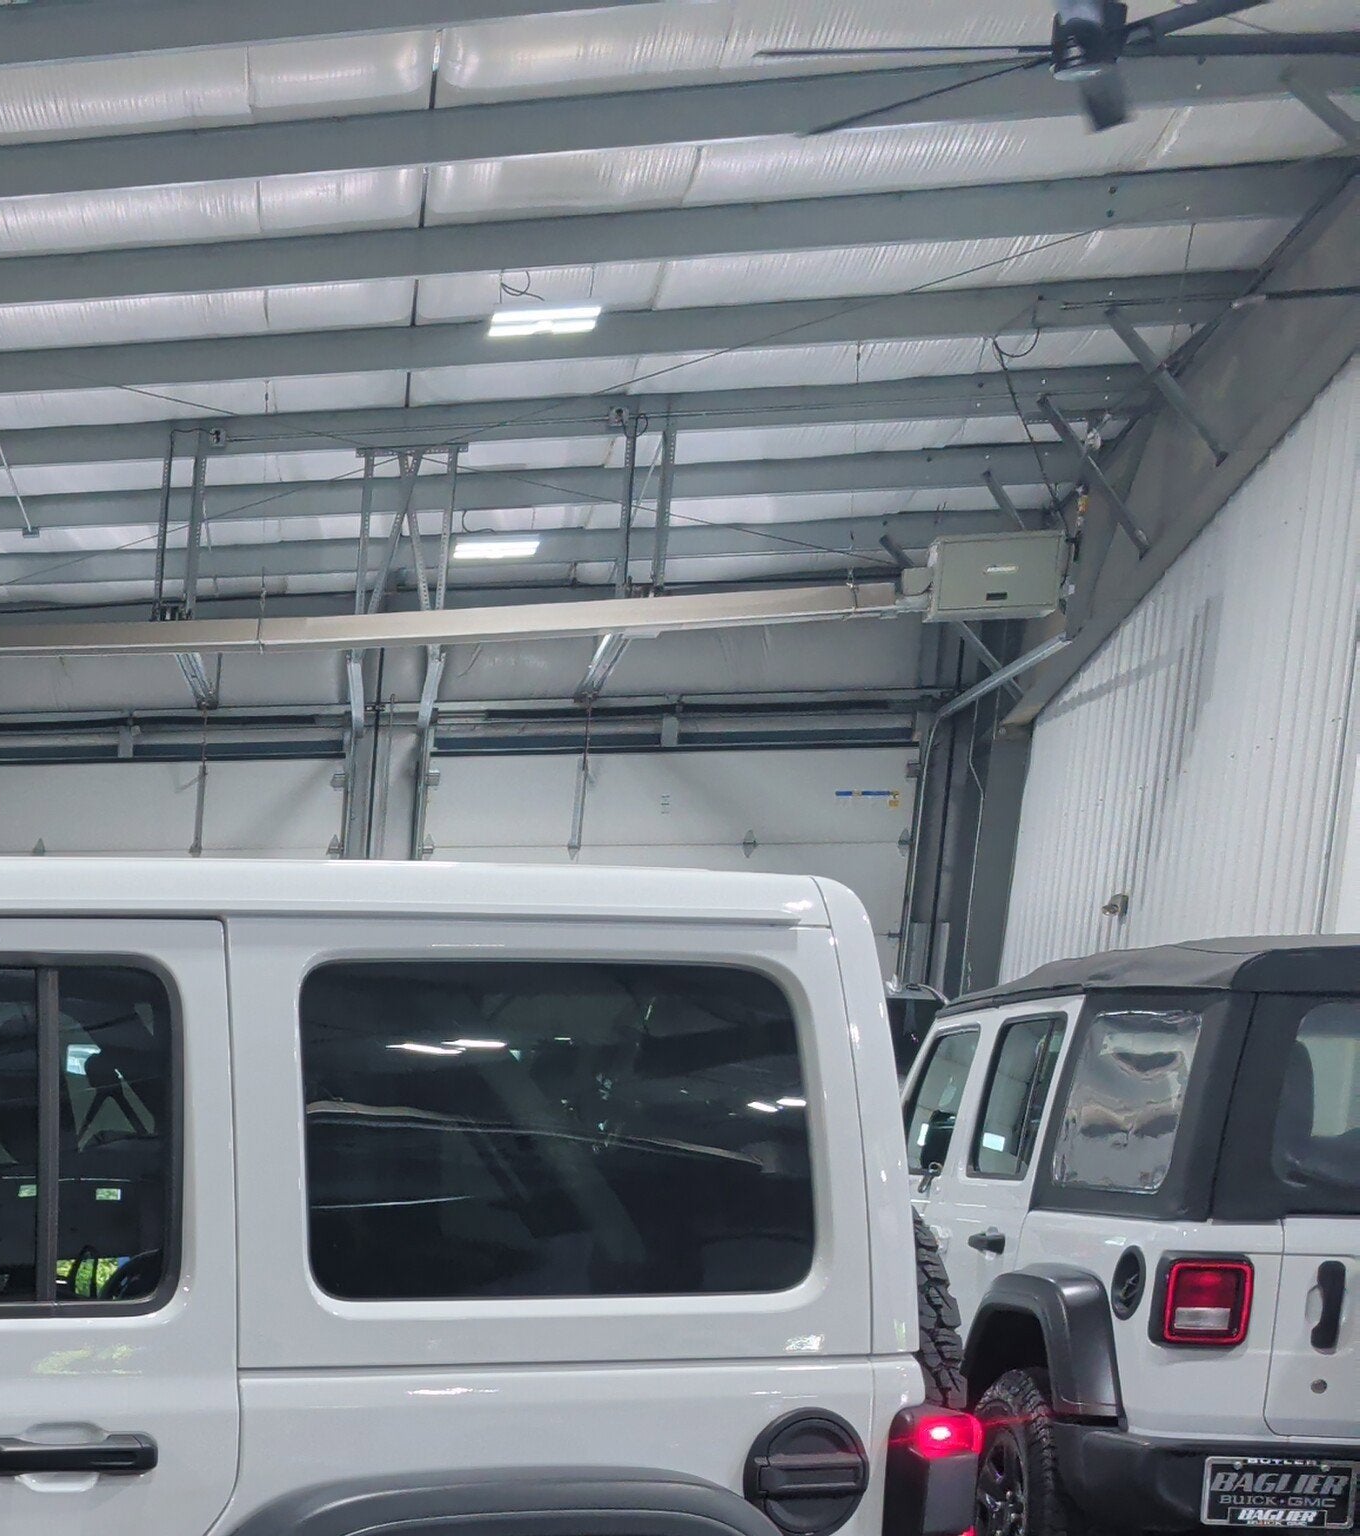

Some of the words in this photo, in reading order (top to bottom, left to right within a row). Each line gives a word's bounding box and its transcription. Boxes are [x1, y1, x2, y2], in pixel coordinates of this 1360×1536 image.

[1210, 1472, 1350, 1495] BAGLIER
[1219, 1494, 1277, 1506] BUICK
[1288, 1496, 1336, 1508] GMC
[1237, 1509, 1318, 1522] BAGLIER
